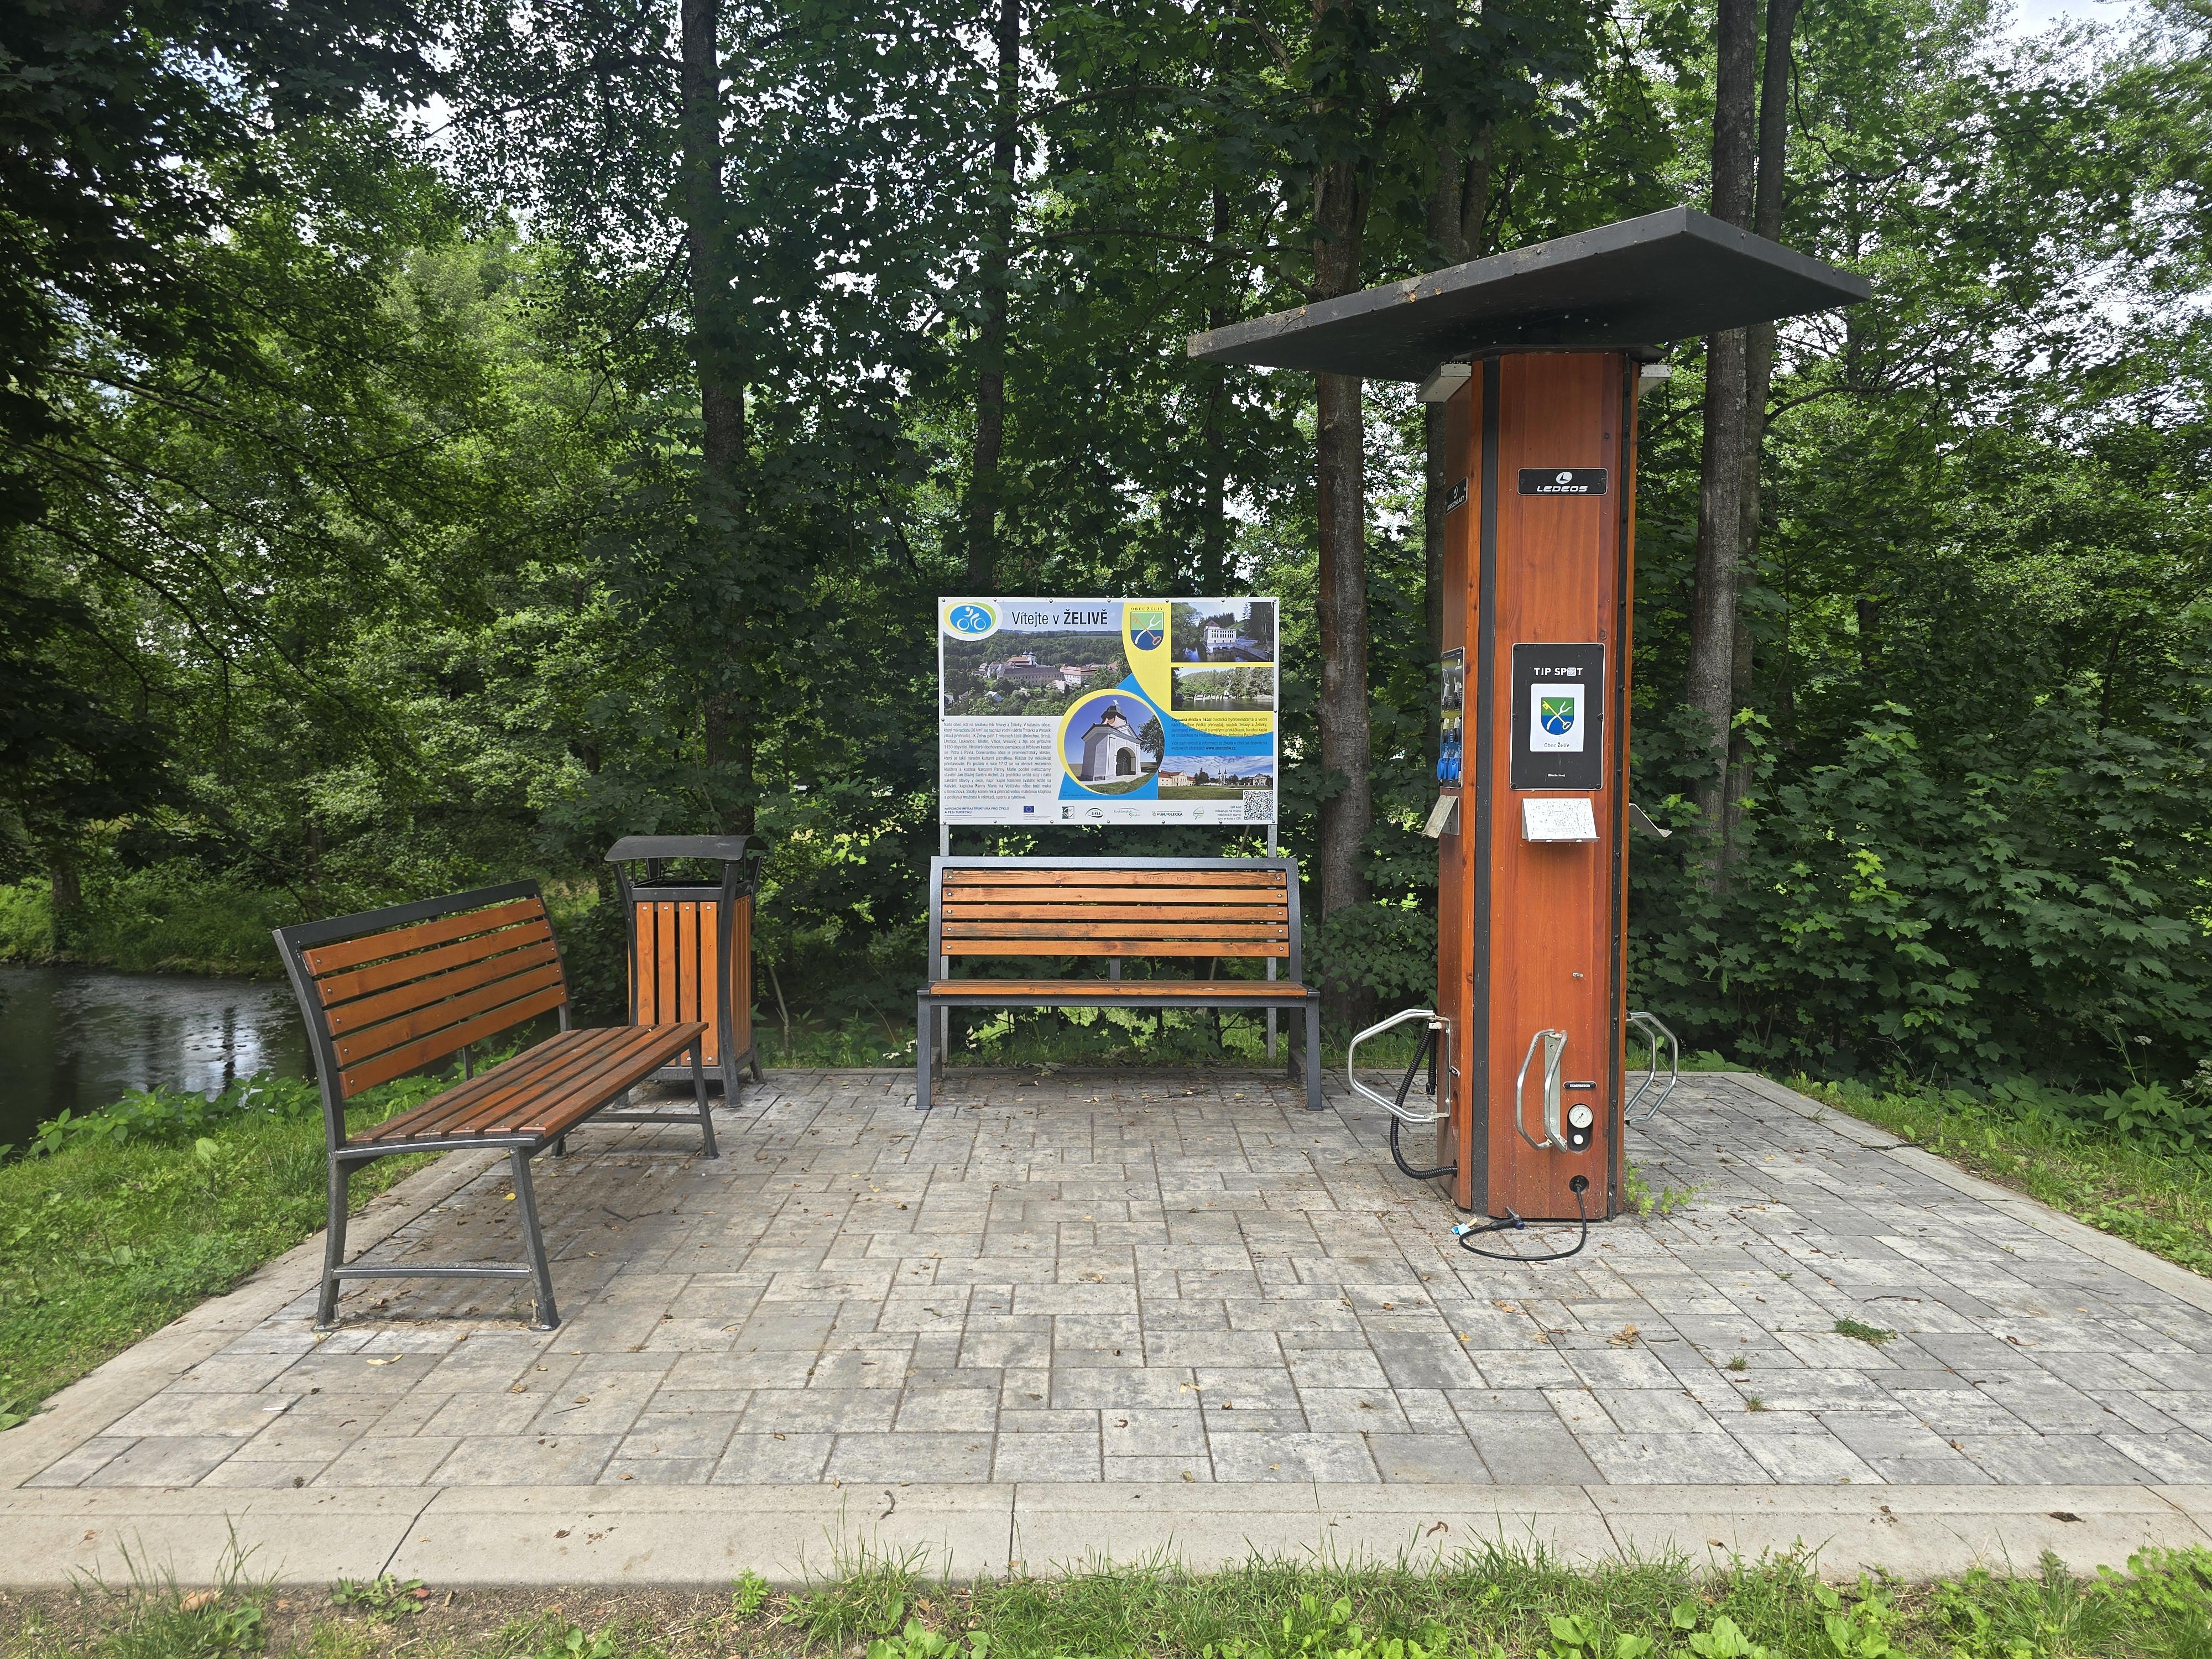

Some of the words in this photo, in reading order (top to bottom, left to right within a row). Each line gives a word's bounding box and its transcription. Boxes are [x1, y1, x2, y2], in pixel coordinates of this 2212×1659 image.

[1012, 611, 1048, 627] Vítejte
[1053, 614, 1059, 625] v
[1063, 609, 1108, 625] ŽELIVĚ
[1534, 667, 1551, 676] TIP
